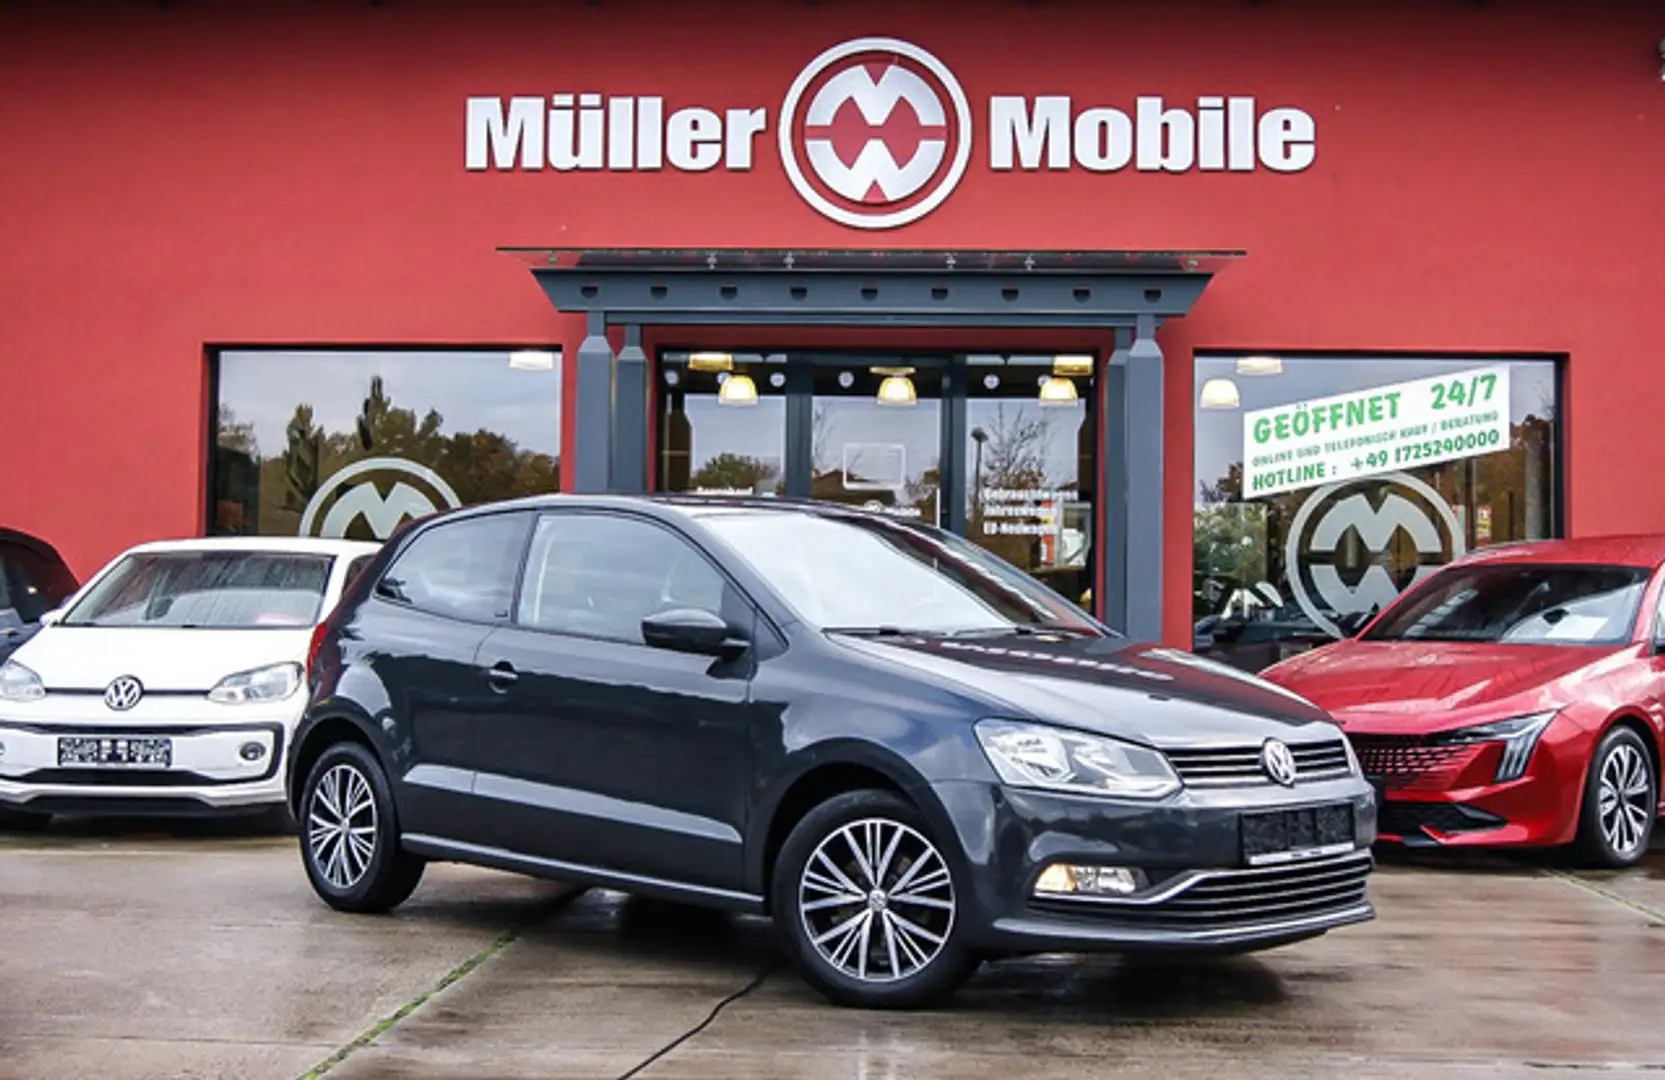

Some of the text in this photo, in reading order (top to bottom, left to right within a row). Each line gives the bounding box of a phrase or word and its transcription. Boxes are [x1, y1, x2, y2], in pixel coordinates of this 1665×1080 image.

[465, 93, 766, 171] Müller
[989, 95, 1316, 172] Mobile
[1251, 449, 1293, 467] ONLINE
[1296, 445, 1321, 458] UND
[1324, 430, 1397, 453] TELEFONISCH
[1440, 410, 1499, 431] BERATUNG
[1253, 373, 1497, 443] GEÖFFNET 24/7
[1252, 462, 1325, 490] HOTLINE
[1350, 450, 1388, 469] +49
[1394, 429, 1500, 463] 1725240000
